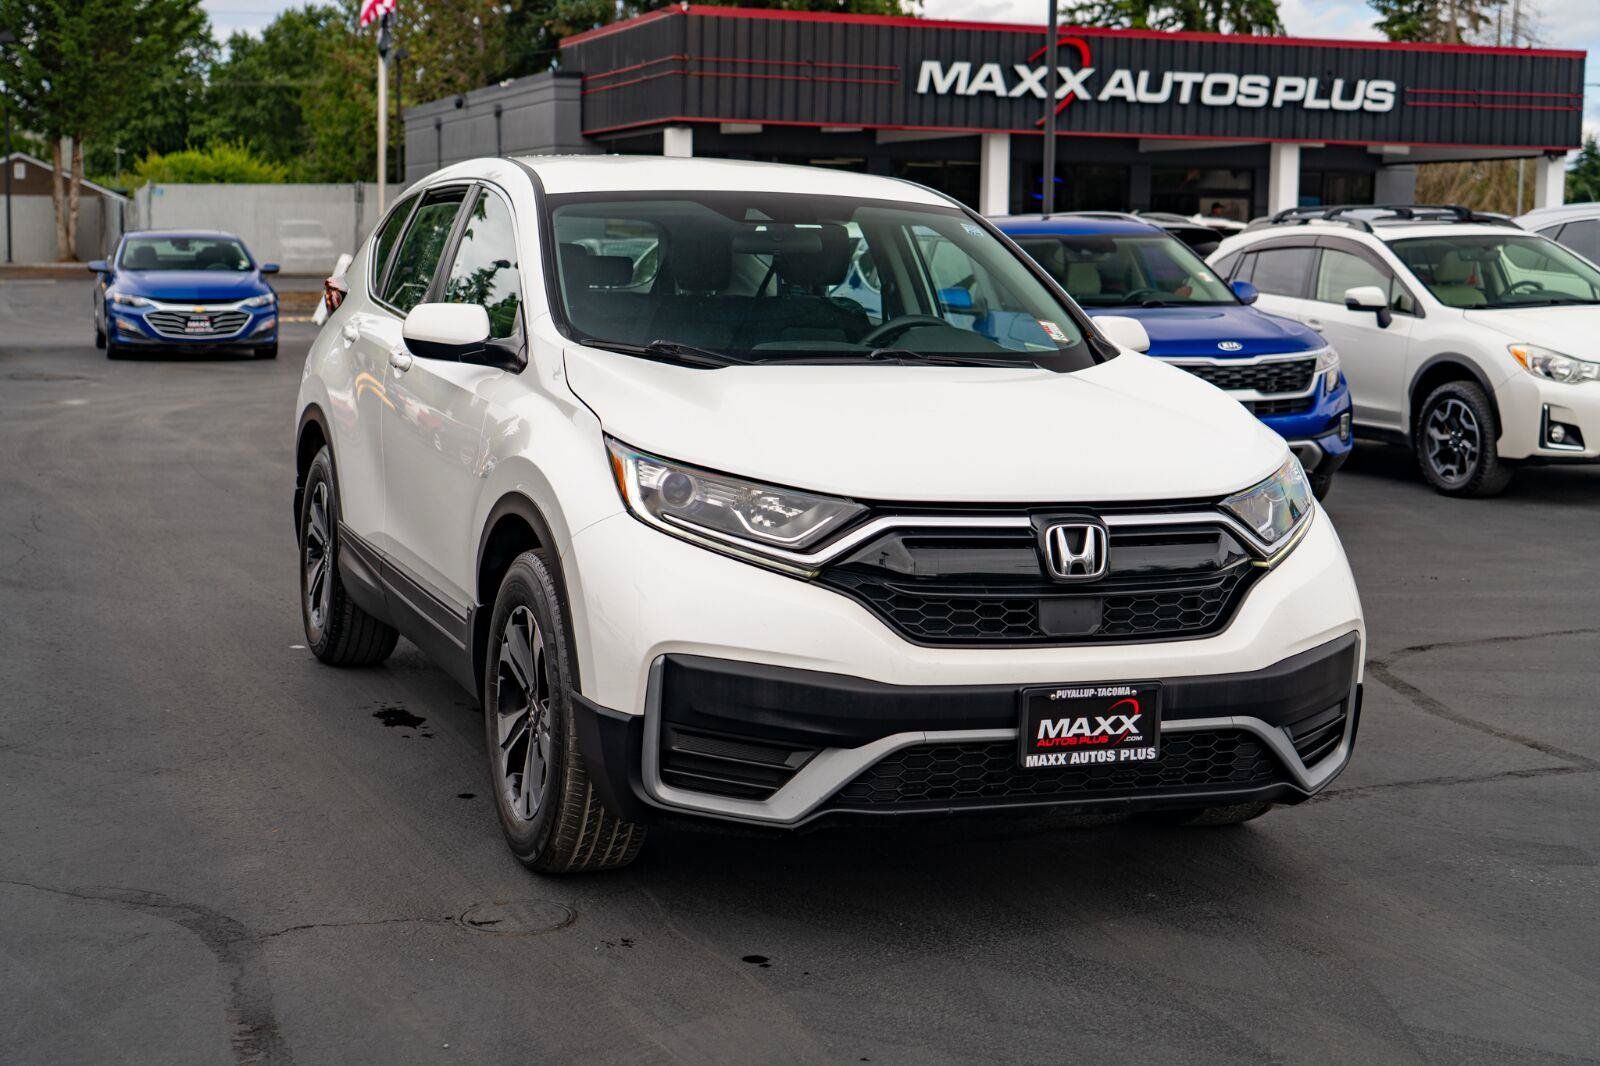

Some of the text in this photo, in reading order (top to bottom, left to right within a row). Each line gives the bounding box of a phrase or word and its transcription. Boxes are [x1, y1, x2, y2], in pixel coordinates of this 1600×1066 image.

[916, 60, 1096, 100] MAXX
[1056, 687, 1131, 699] PUYALLUP-TACOMA
[1037, 713, 1142, 739] MAXX
[1037, 735, 1109, 747] AUTOS PLUS
[1026, 747, 1156, 767] MAXX AUTOS PLUS
